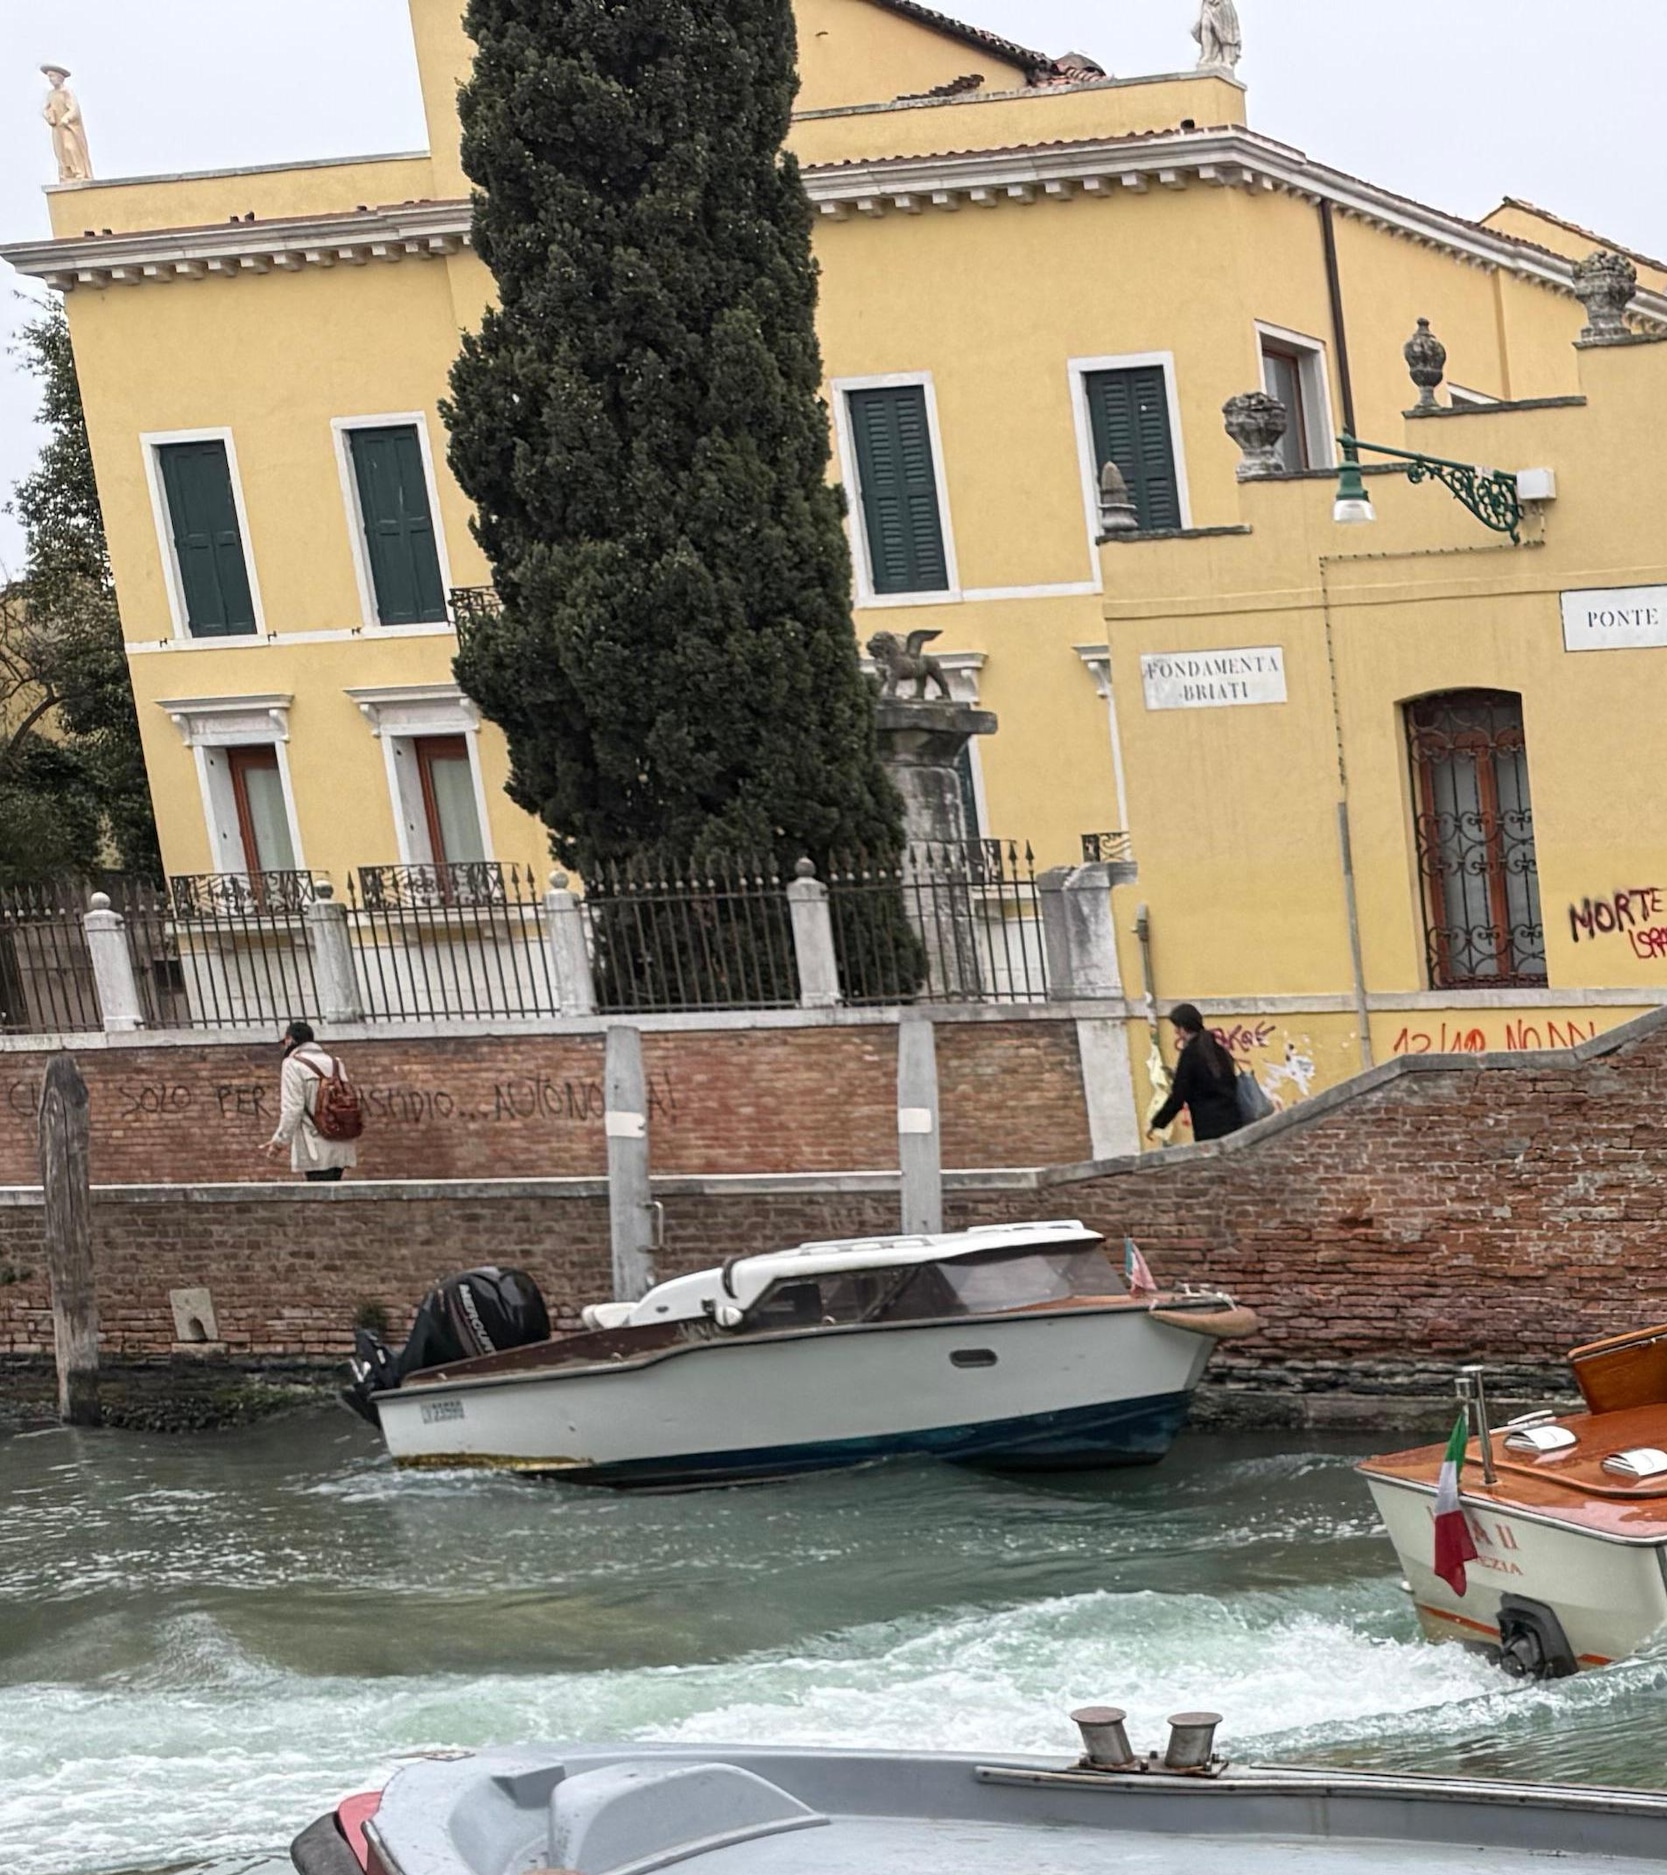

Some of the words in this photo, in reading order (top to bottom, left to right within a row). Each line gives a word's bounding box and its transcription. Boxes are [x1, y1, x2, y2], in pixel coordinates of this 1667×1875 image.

[1588, 608, 1658, 628] PONTE
[1147, 655, 1279, 680] FONDAMENTA
[1183, 682, 1248, 701] BRIATI
[1569, 887, 1664, 943] MORTE
[118, 1081, 192, 1118] SOLO
[214, 1084, 272, 1118] PER
[356, 1085, 489, 1124] ASTIDIO...
[493, 1071, 677, 1125] AUTONOA!
[459, 1284, 498, 1355] MERCUR
